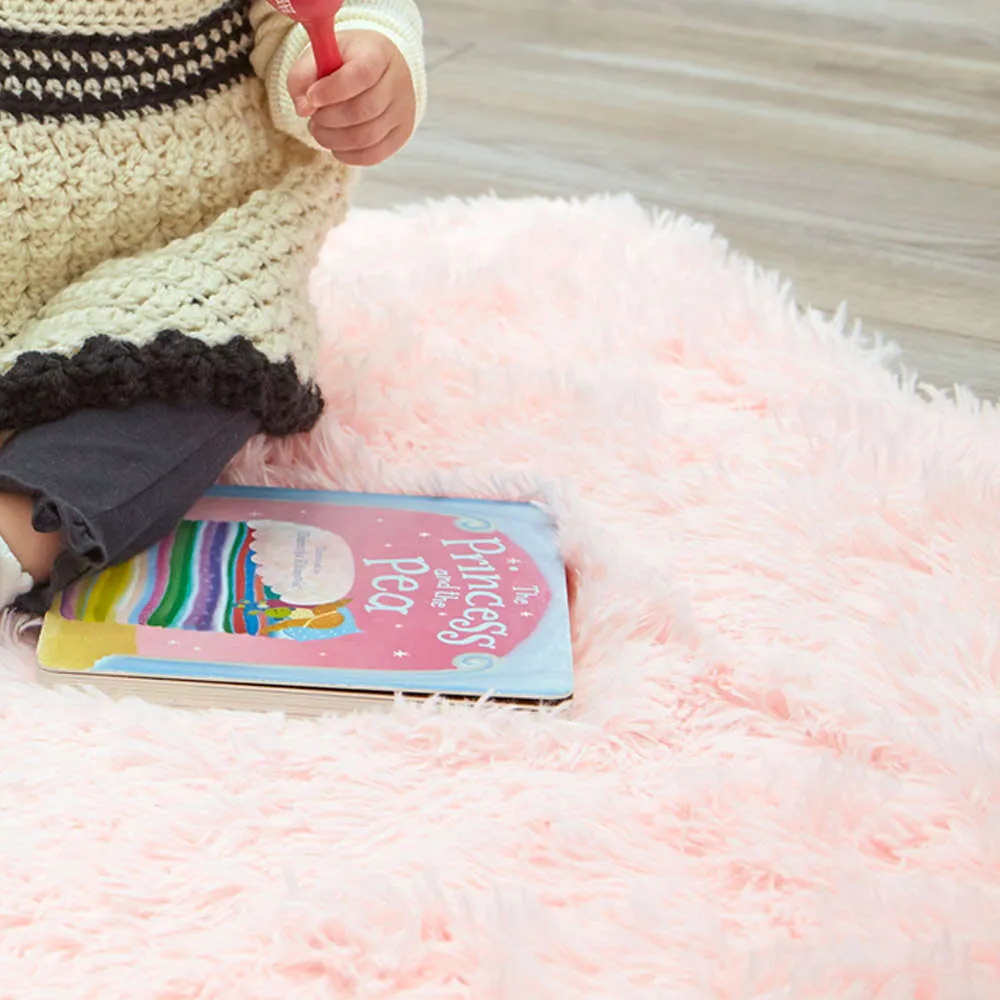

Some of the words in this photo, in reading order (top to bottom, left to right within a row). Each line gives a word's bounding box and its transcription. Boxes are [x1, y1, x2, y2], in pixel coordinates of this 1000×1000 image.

[362, 556, 431, 616] Pea
[434, 569, 461, 589] and
[430, 591, 459, 609] the
[436, 536, 508, 650] Princess
[511, 584, 541, 605] The
